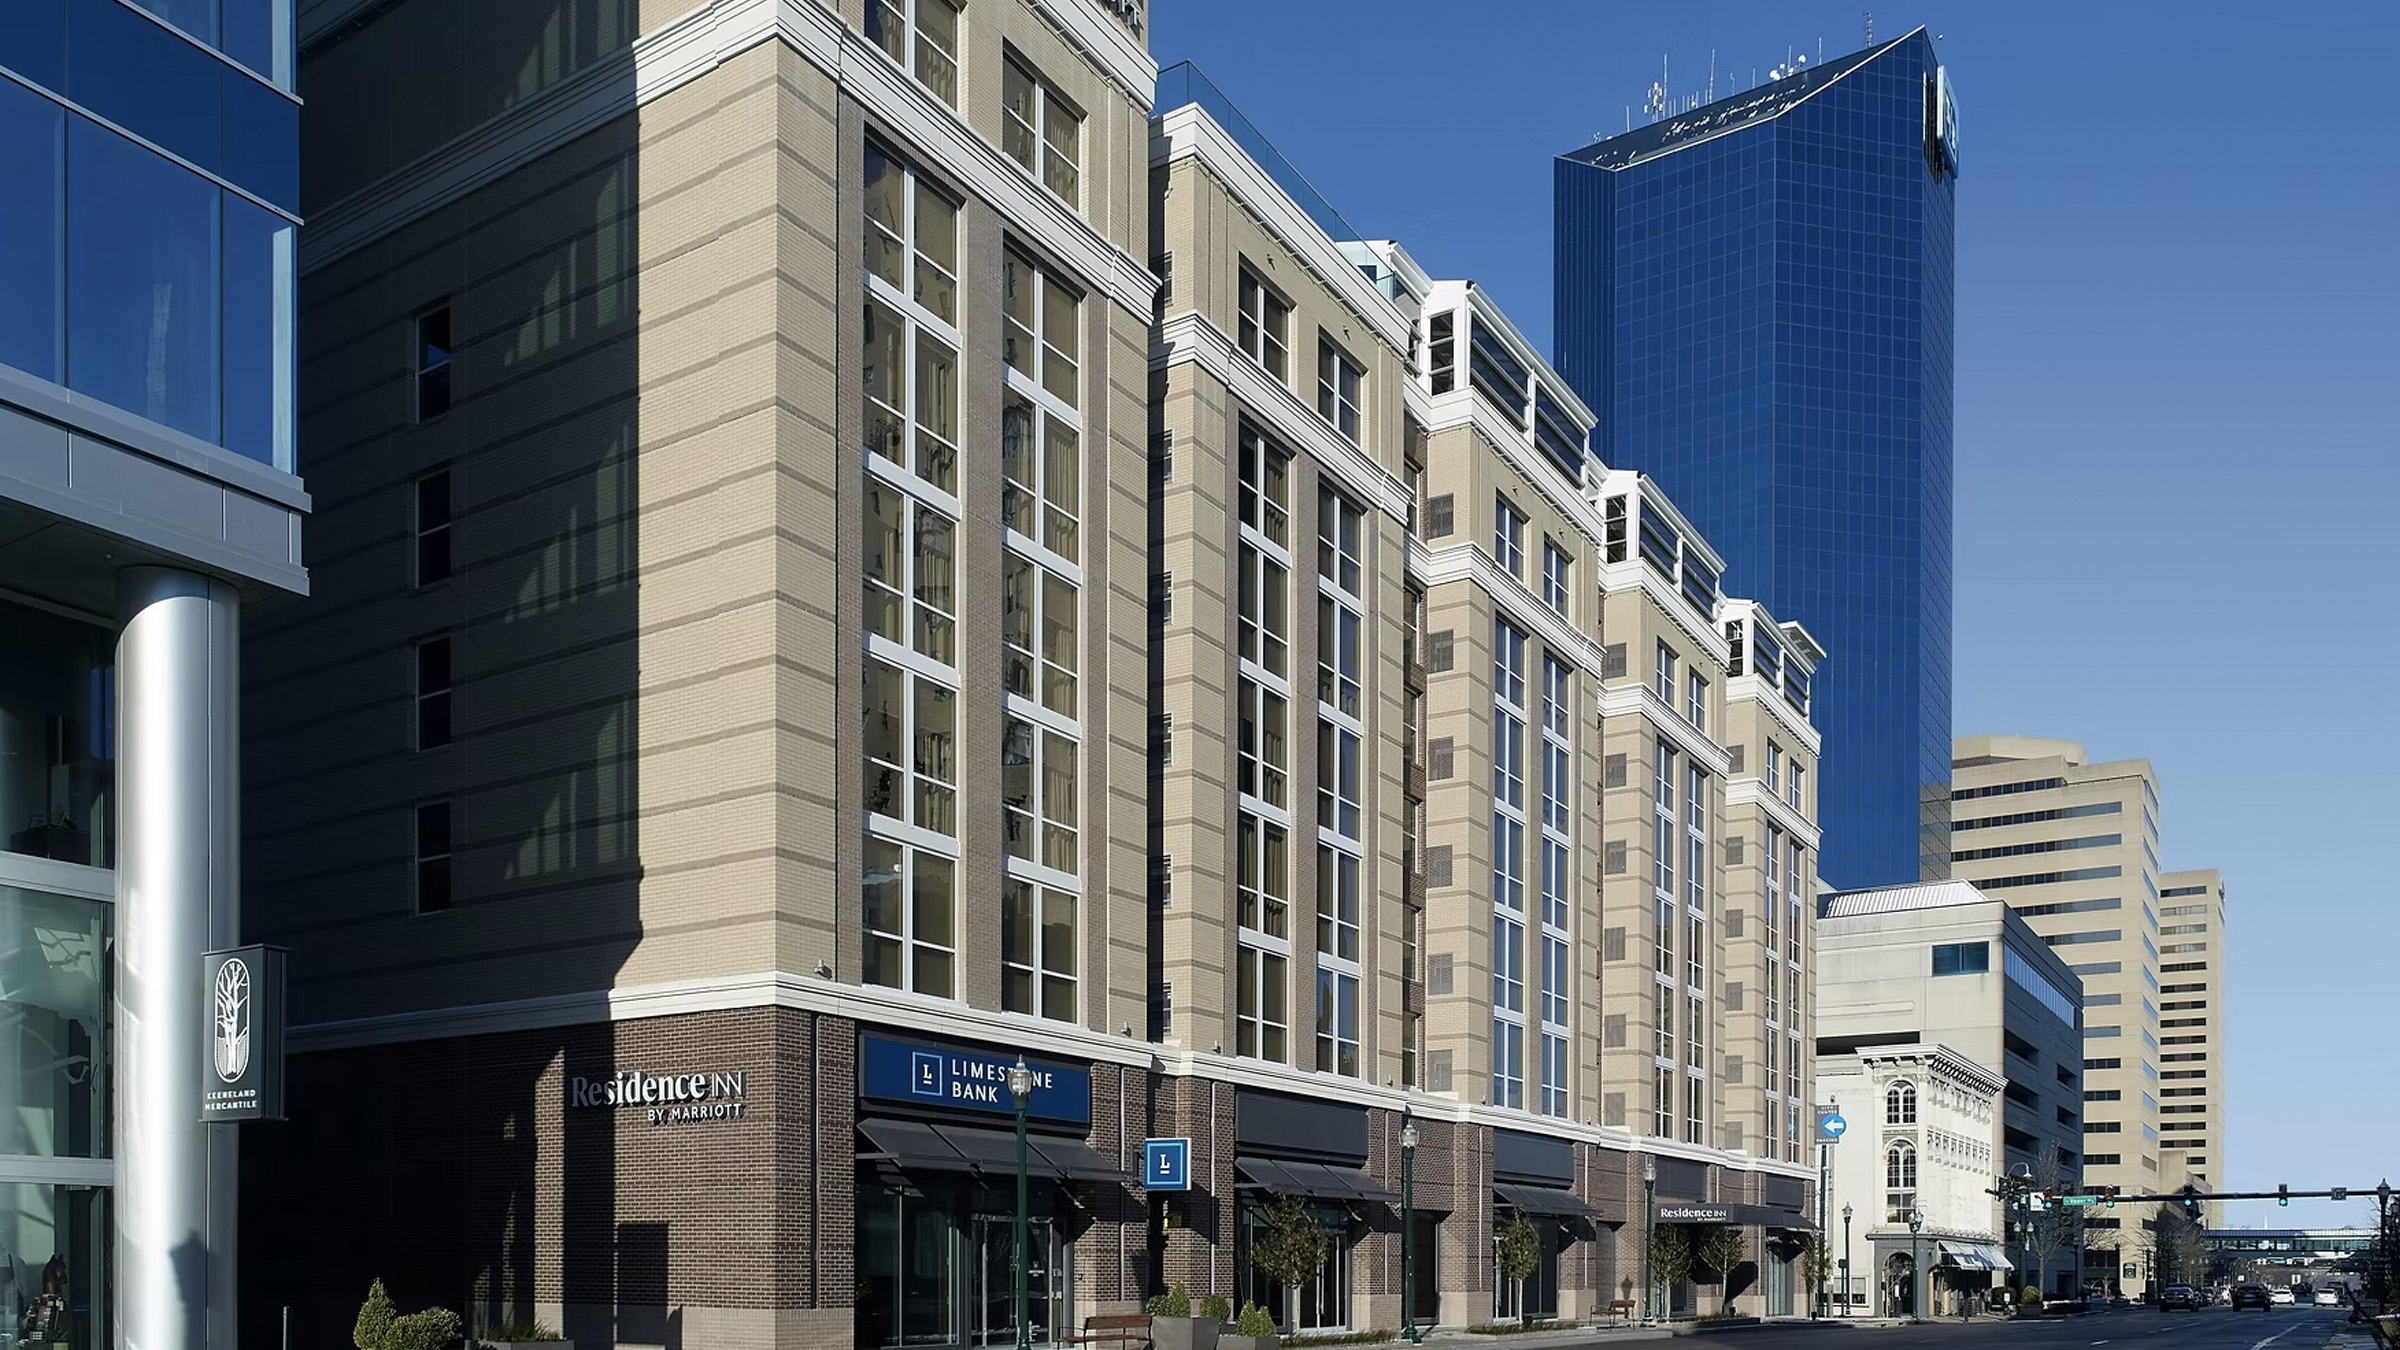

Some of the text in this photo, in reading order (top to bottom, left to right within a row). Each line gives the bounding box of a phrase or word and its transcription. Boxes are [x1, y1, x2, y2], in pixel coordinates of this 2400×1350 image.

[923, 1064, 933, 1080] L
[952, 1058, 1053, 1090] LIMESNE
[207, 1089, 256, 1100] KEENELAND
[571, 1071, 742, 1107] Residence INN
[952, 1081, 999, 1103] BANK
[204, 1100, 258, 1111] MERCANTILE
[648, 1103, 742, 1121] BY MARRIOTT
[1160, 1153, 1170, 1169] L
[1660, 1207, 1713, 1218] Residence
